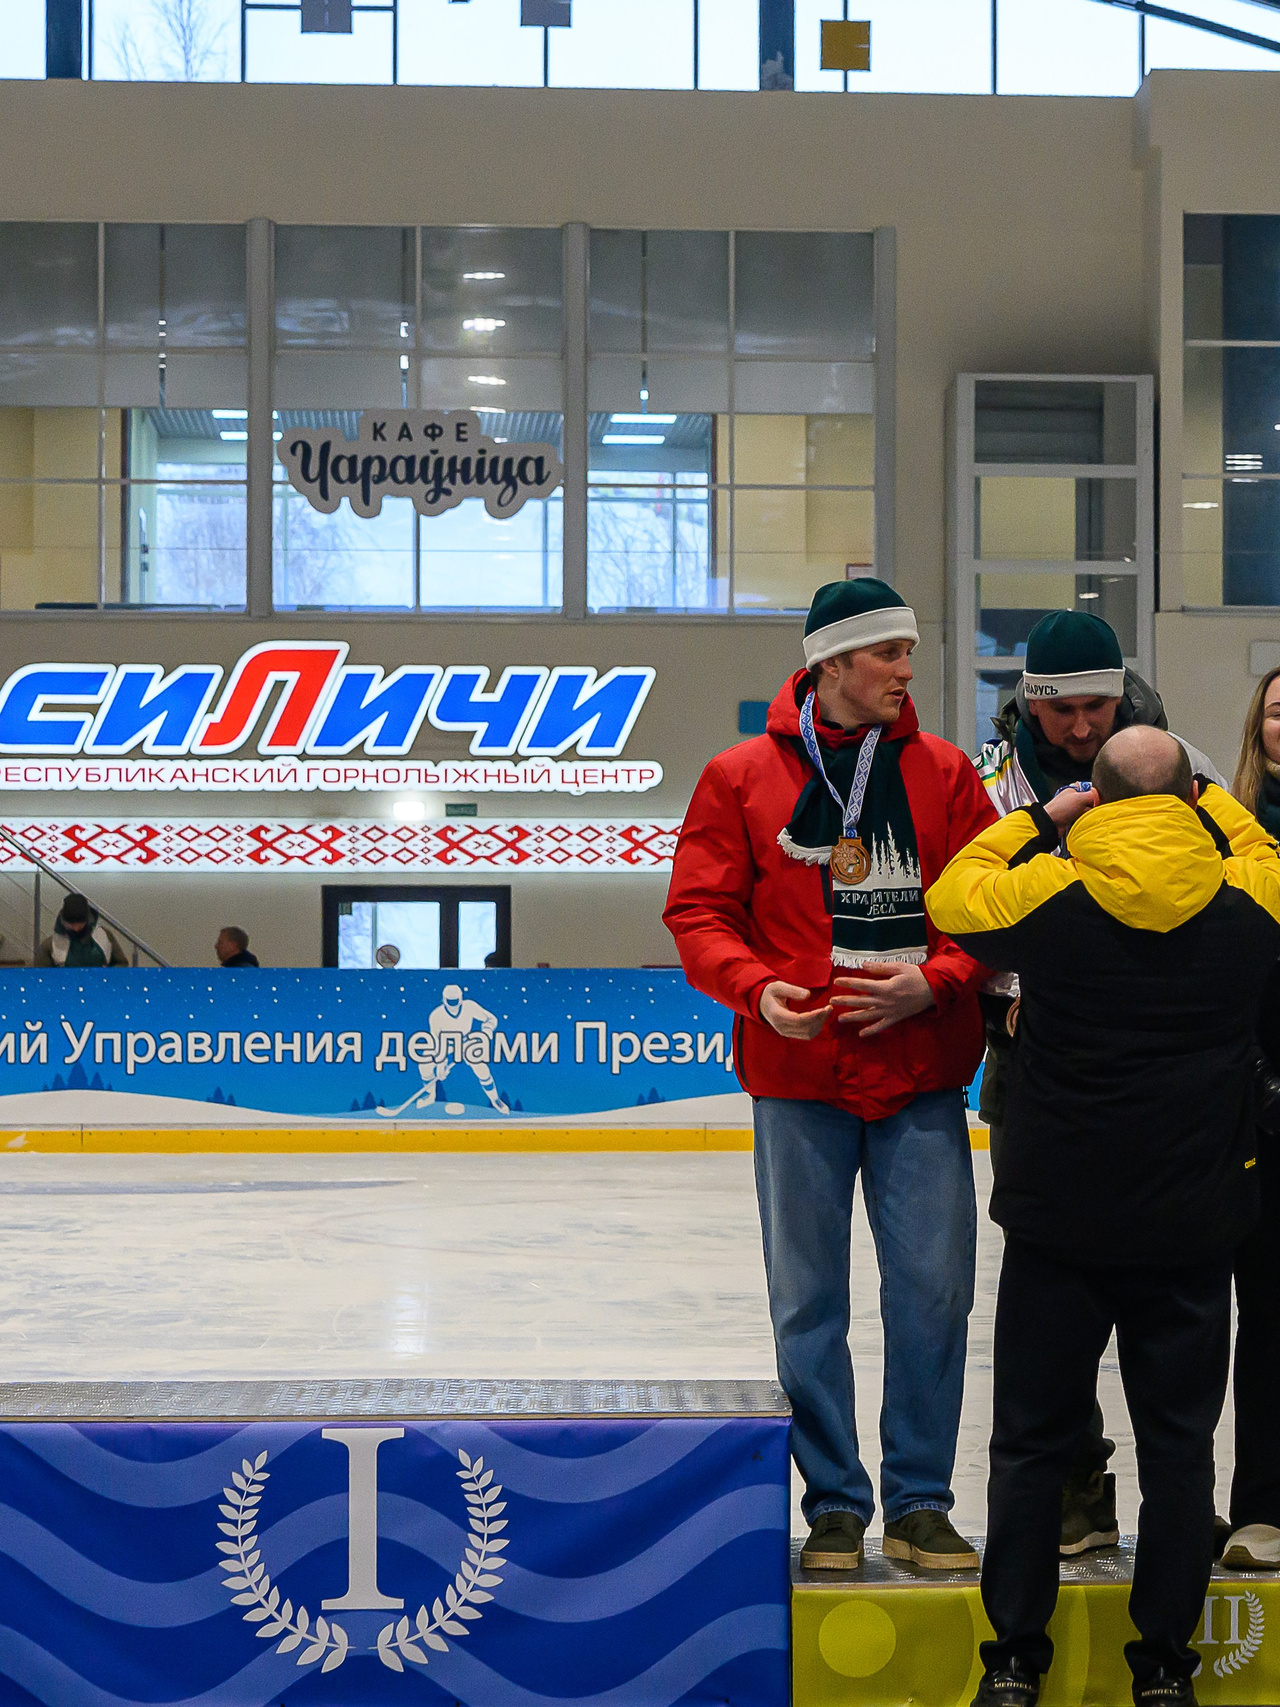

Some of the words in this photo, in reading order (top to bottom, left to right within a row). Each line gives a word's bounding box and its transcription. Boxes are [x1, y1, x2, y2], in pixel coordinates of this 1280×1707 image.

[372, 422, 469, 442] КАФЕ
[0, 763, 297, 783] ЕСПУБЛИКАНСКИЙ
[306, 763, 551, 784] ГОРНОЛЫЖНЫЙ
[561, 767, 655, 788] ЦЕНТР
[61, 1021, 362, 1075] Управления
[375, 1031, 559, 1072] делами
[1188, 1595, 1245, 1645] II
